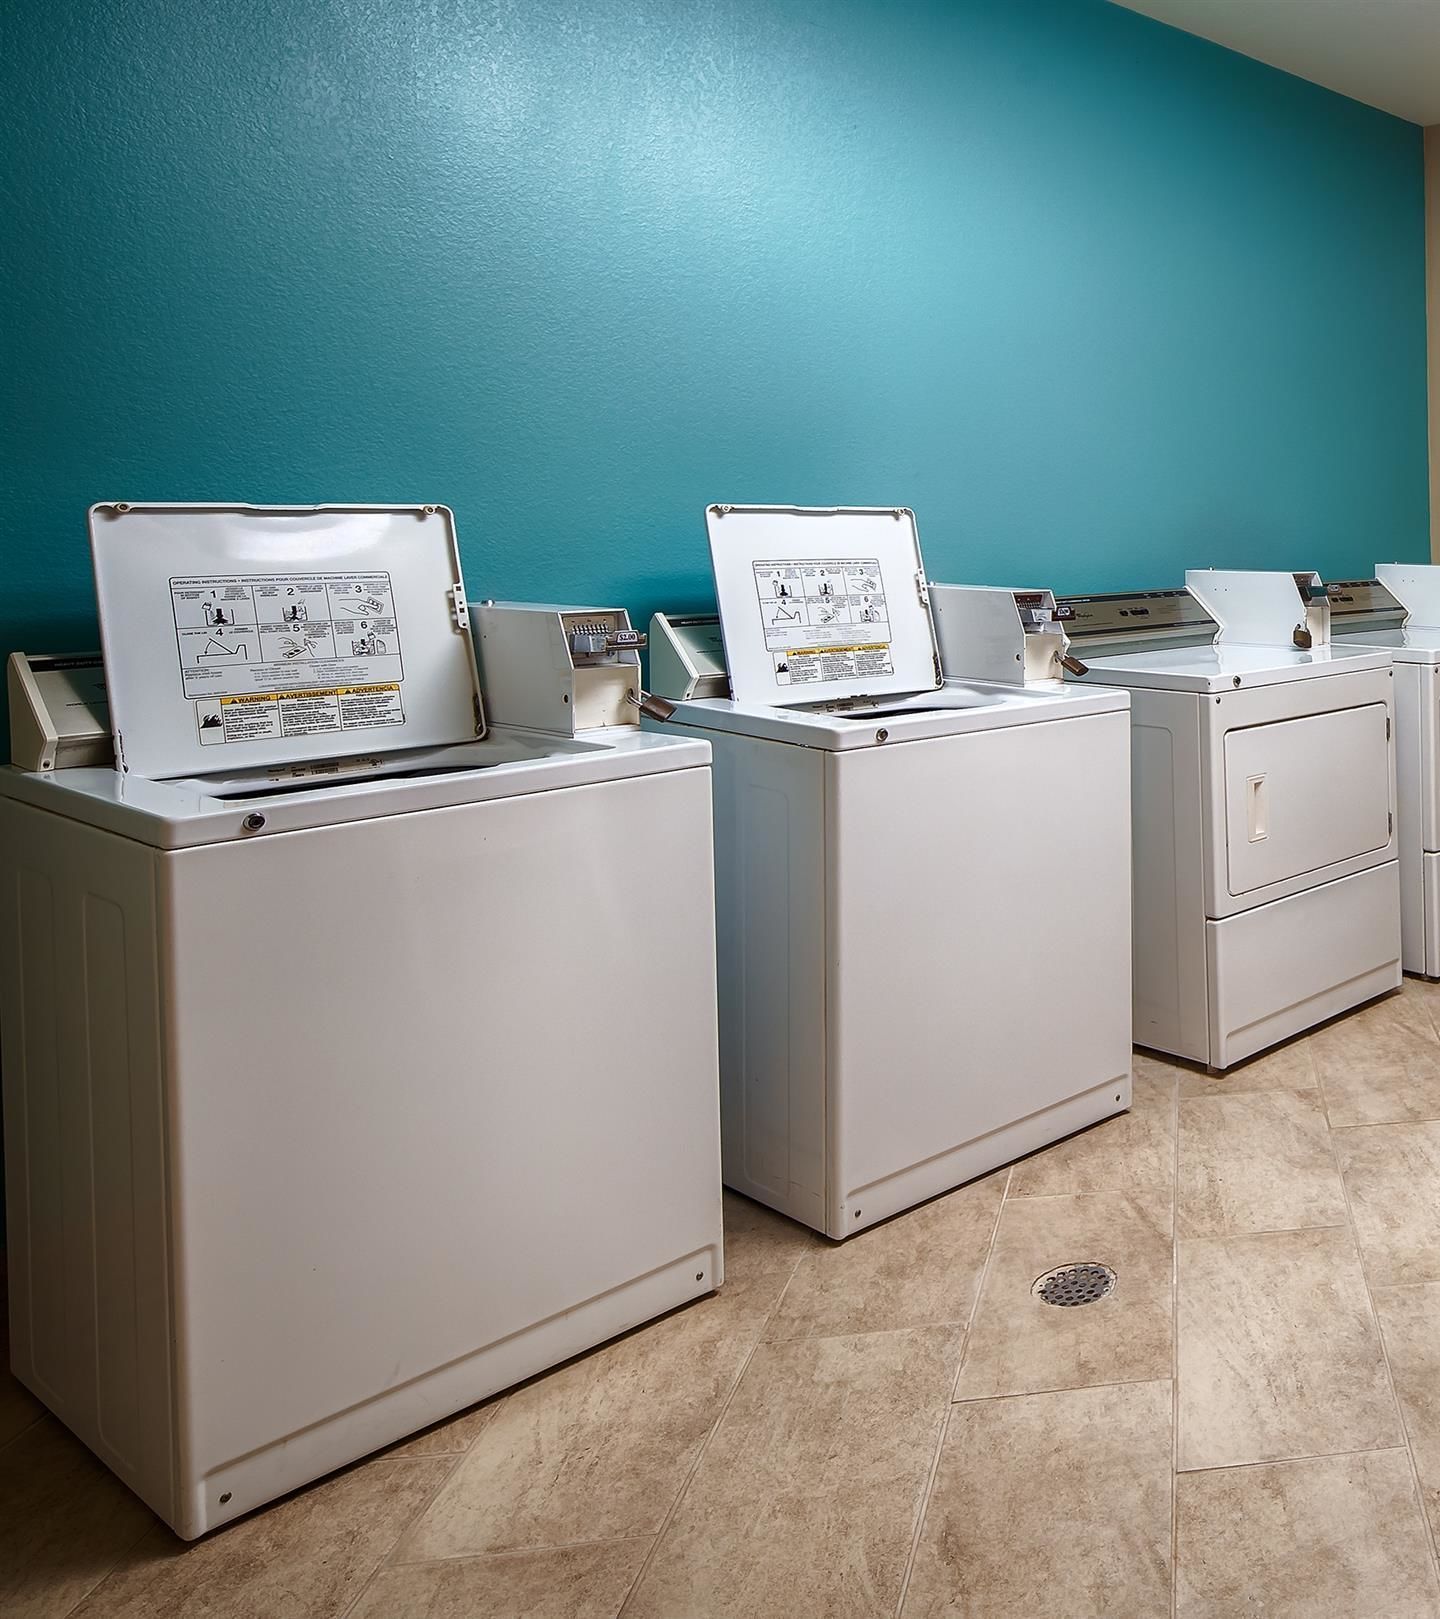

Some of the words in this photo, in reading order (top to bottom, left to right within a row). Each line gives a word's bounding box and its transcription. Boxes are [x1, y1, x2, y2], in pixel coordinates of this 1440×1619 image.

[286, 587, 295, 596] 2
[354, 585, 363, 594] 3
[210, 590, 217, 599] 1
[292, 624, 301, 632] 5
[360, 621, 368, 629] 6
[215, 628, 224, 636] 4
[619, 633, 636, 641] $2.00
[238, 695, 271, 704] WARNING
